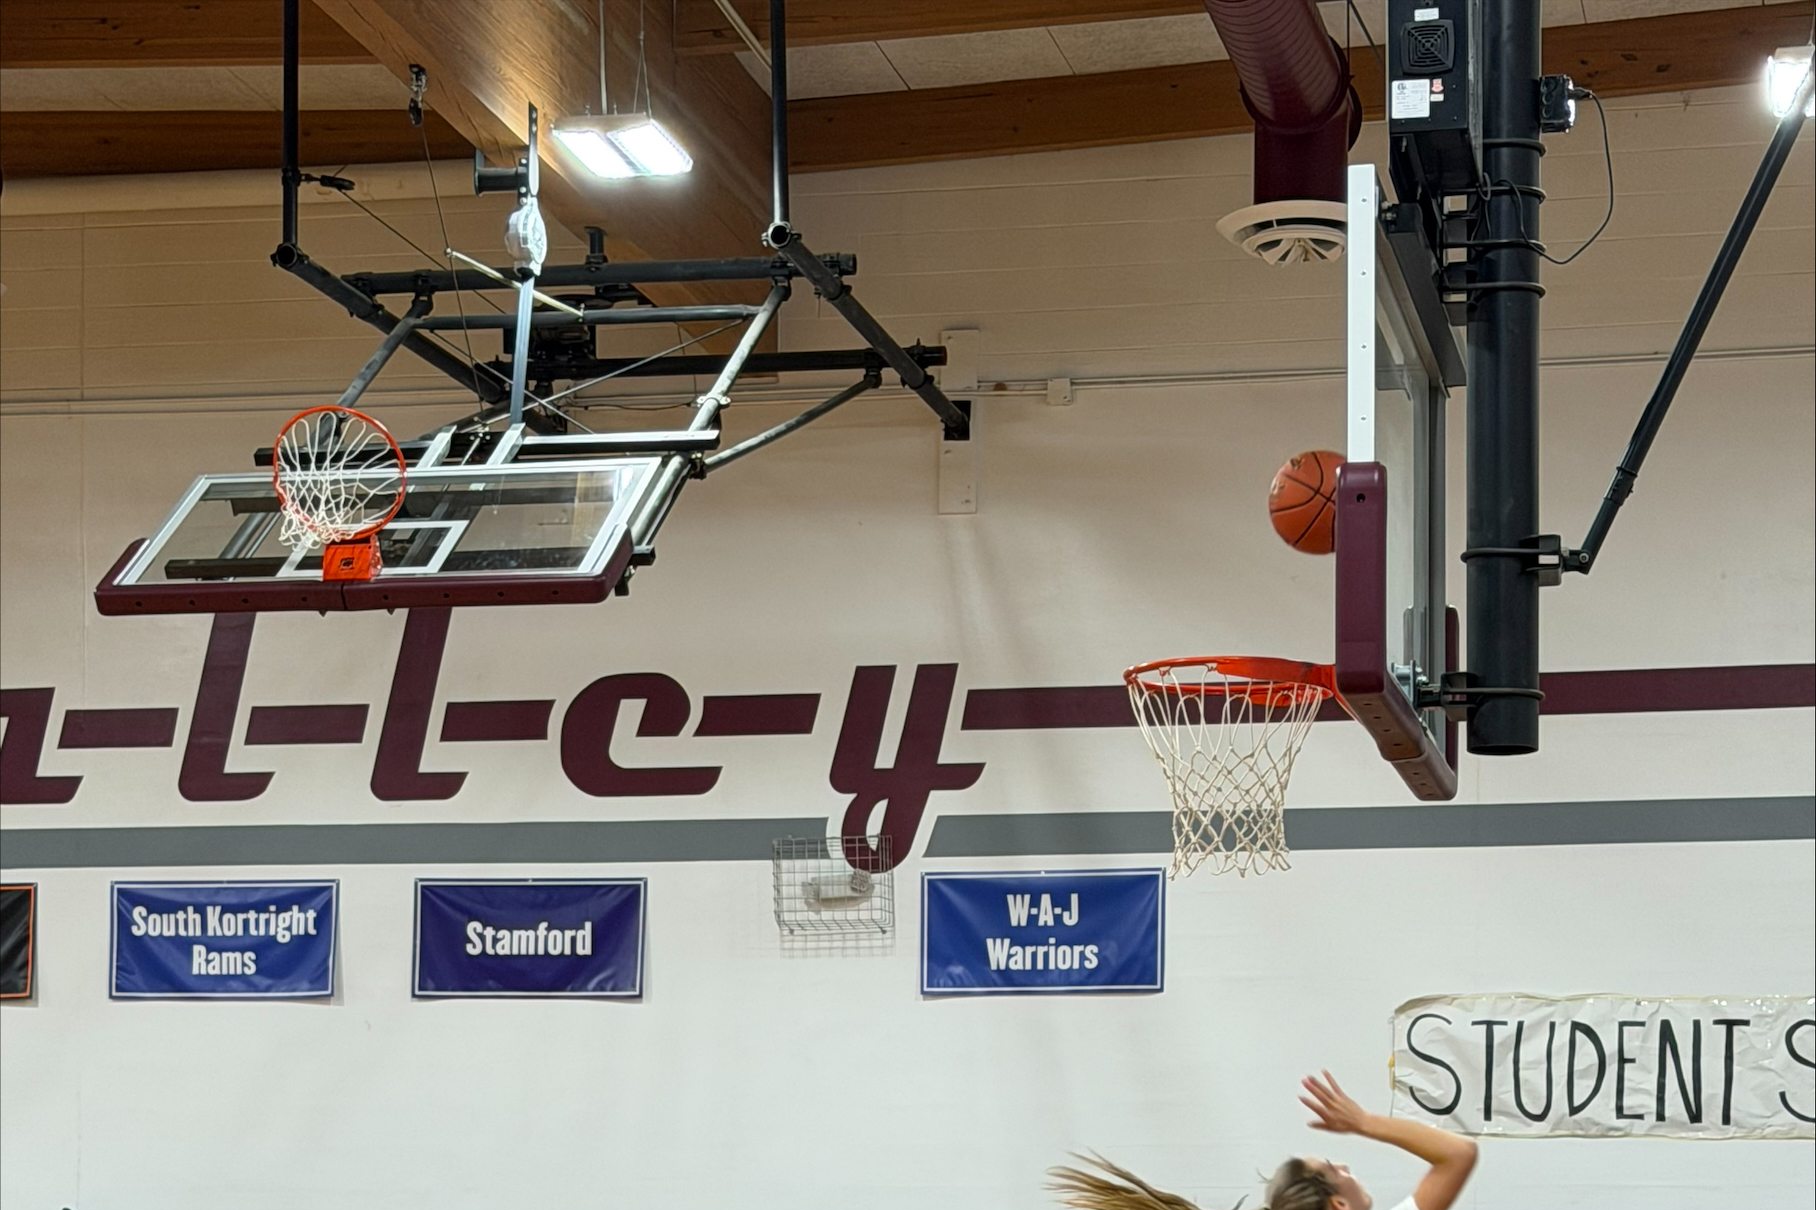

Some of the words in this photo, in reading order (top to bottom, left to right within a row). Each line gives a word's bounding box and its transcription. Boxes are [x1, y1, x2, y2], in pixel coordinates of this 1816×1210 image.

[131, 905, 202, 937] South
[206, 904, 317, 943] Kortright
[1006, 893, 1079, 927] W-A-J
[465, 920, 592, 956] Stamford
[986, 937, 1099, 970] Warriors
[192, 944, 257, 975] Rams
[1406, 1013, 1751, 1126] STUDENT
